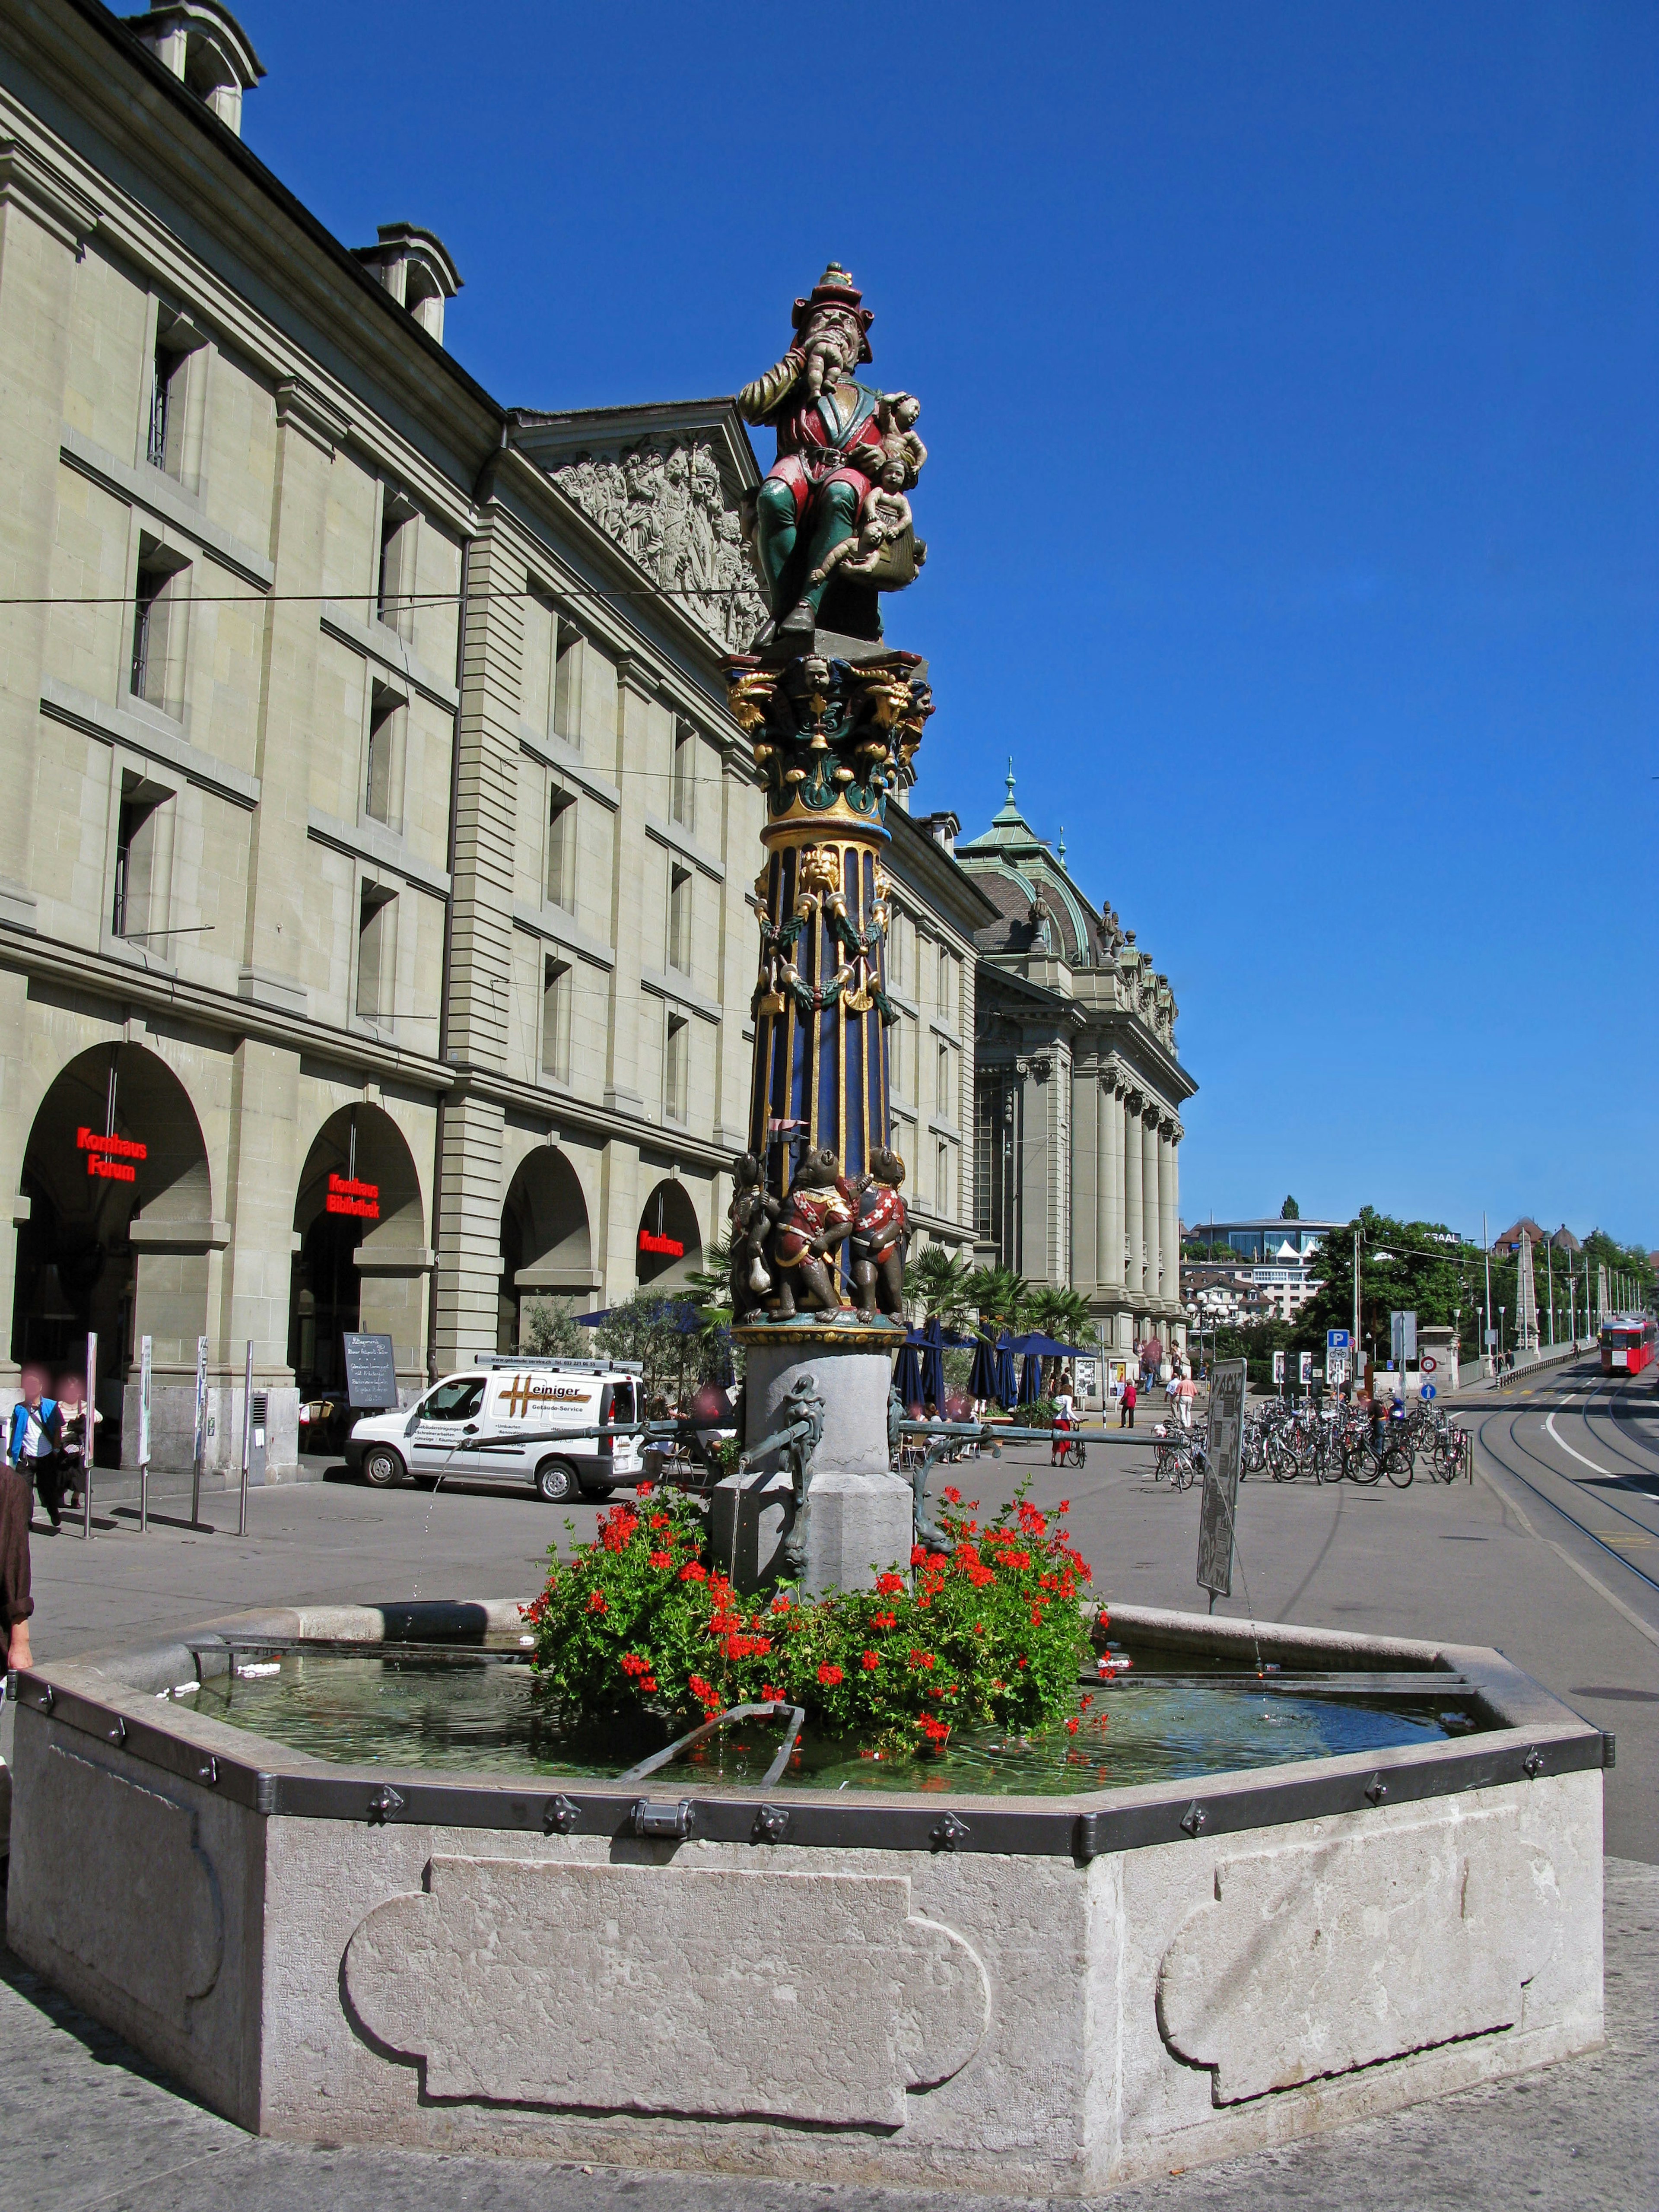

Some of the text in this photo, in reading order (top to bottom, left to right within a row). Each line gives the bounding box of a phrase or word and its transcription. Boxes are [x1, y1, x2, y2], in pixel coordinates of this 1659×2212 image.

[77, 1127, 147, 1160] Kornhaus
[88, 1154, 135, 1182] Forum
[329, 1173, 379, 1200] Kornhaus
[326, 1193, 380, 1219] Bibliothek
[640, 1230, 684, 1258] Kornhaus
[1333, 1333, 1344, 1345] P
